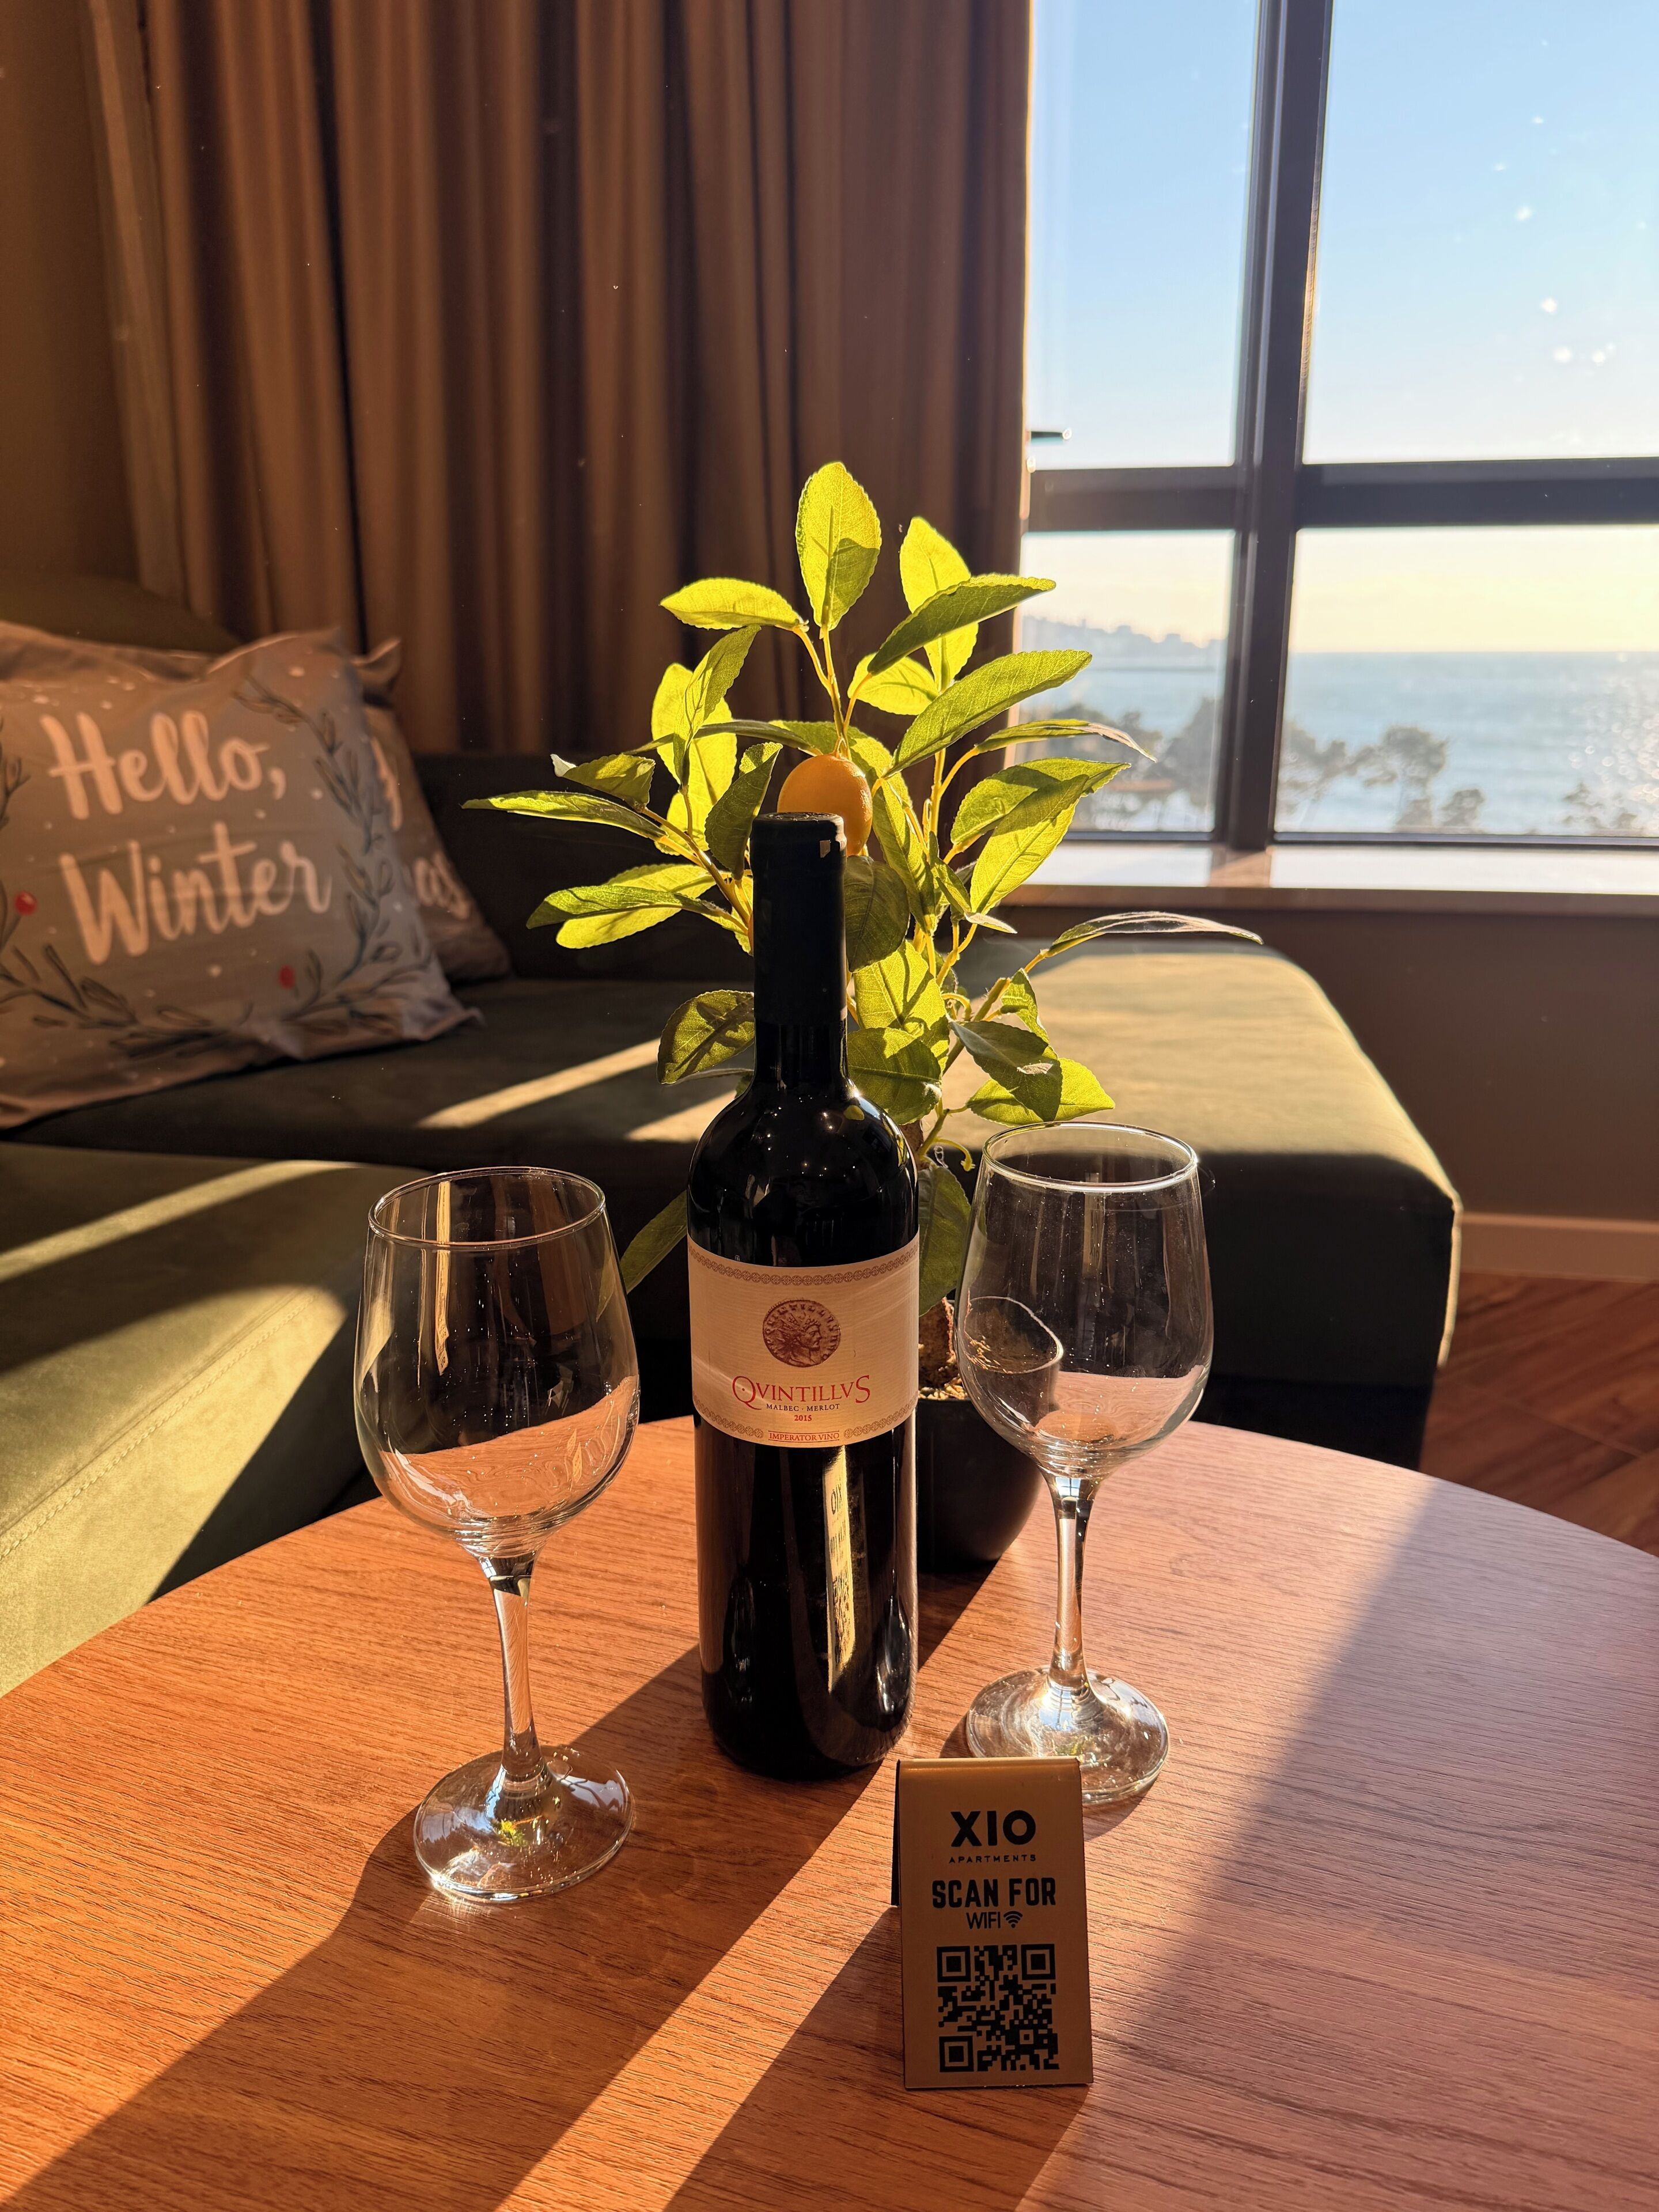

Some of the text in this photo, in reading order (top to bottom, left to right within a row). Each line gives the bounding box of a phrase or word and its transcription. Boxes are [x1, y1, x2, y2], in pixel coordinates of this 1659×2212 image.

[39, 710, 287, 820] Hello,
[59, 821, 333, 964] Winter
[766, 1403, 840, 1411] MALBEC MERLOT
[769, 1432, 840, 1441] IMPERATOR VINO
[950, 1809, 1036, 1847] XIO
[949, 1854, 1036, 1864] APARTMENTS
[931, 1877, 1056, 1909] SCAN FOR
[966, 1911, 1001, 1930] WIFI
